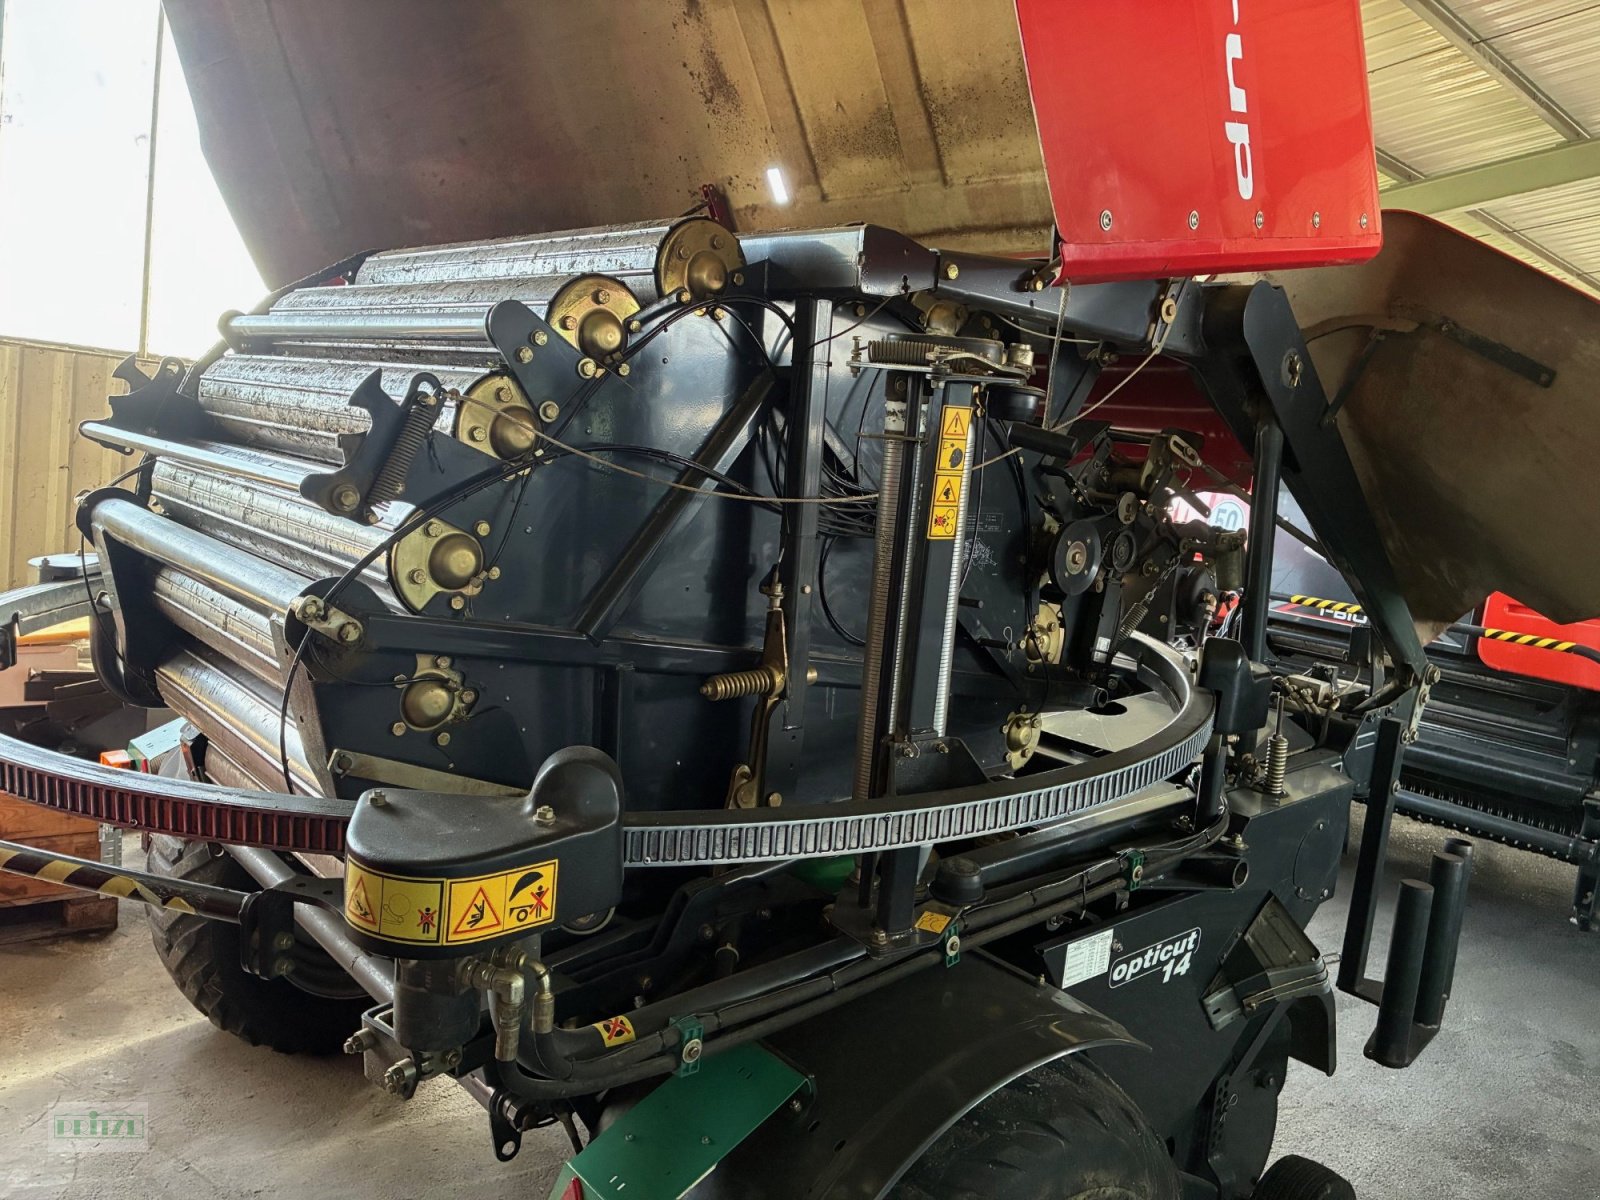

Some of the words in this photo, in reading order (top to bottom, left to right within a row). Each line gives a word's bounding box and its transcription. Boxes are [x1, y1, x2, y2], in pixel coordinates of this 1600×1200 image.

[1225, 0, 1254, 200] up
[1214, 507, 1239, 529] 50
[1112, 931, 1198, 981] opticut
[1161, 951, 1193, 984] 14
